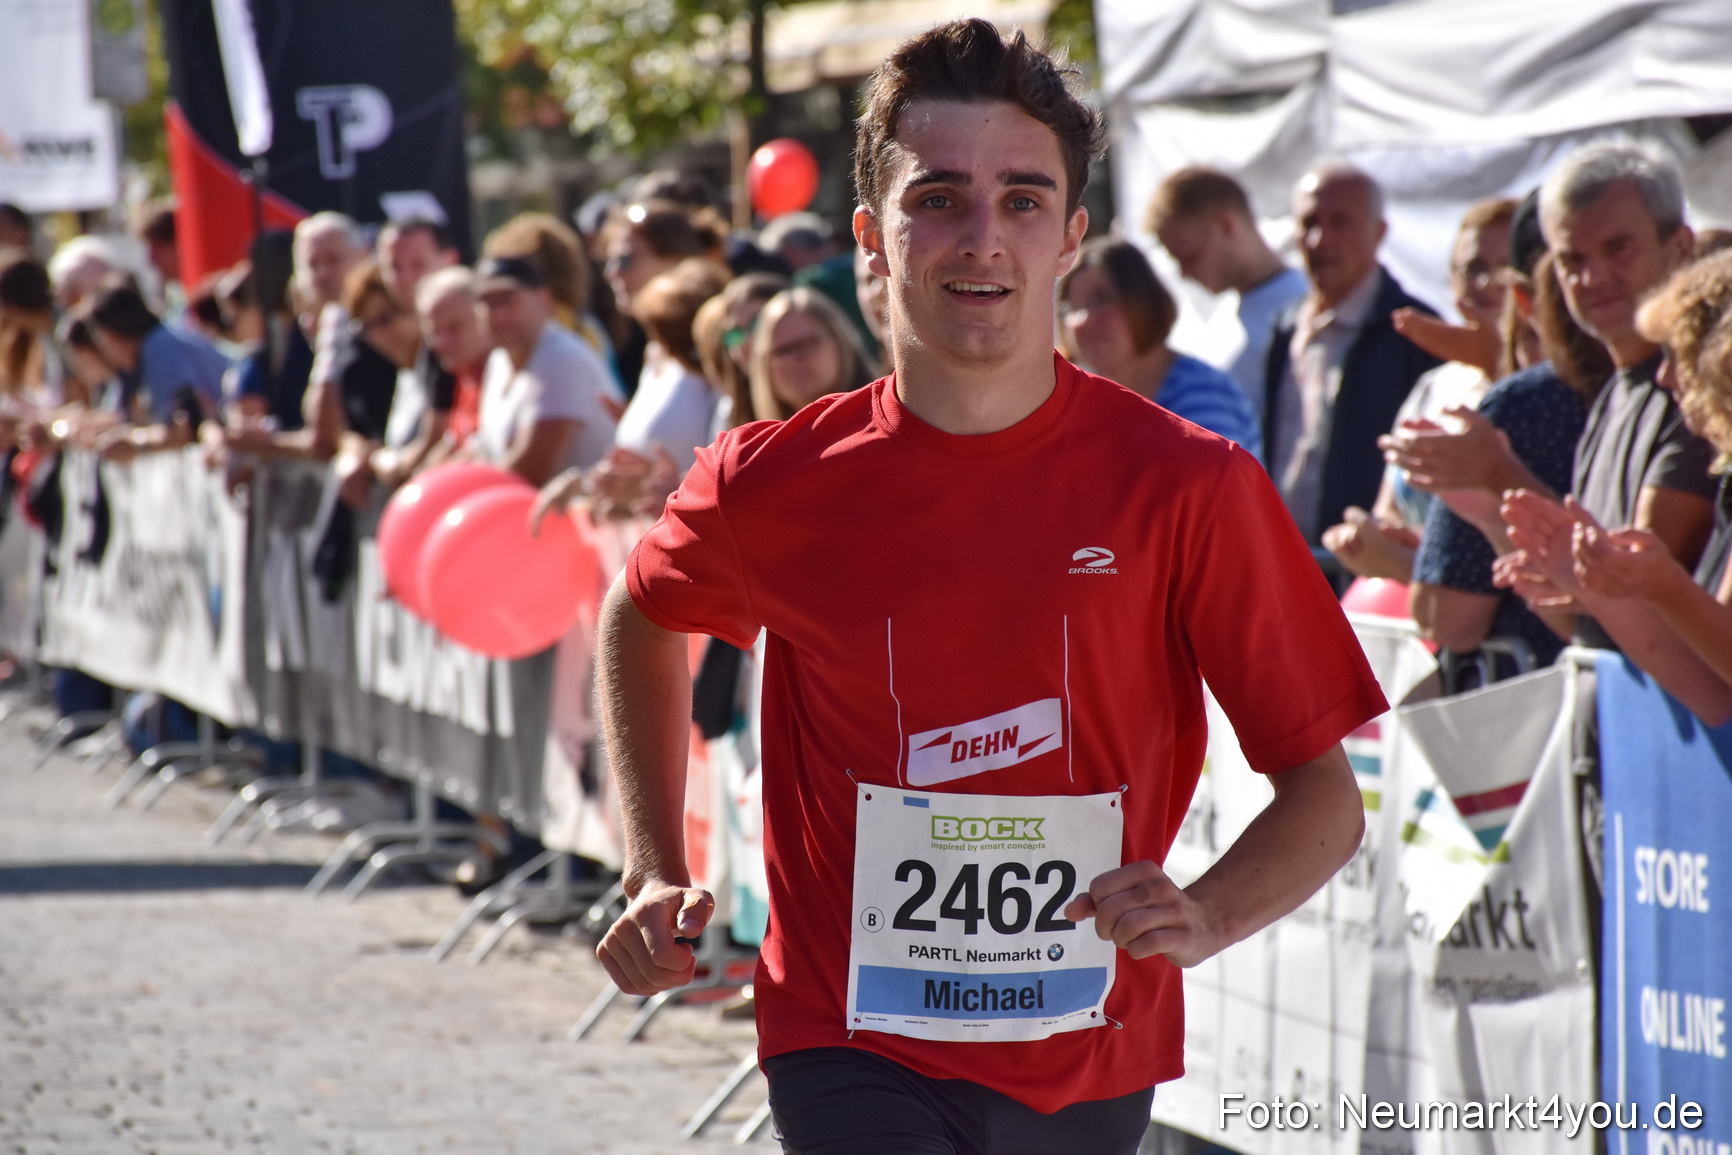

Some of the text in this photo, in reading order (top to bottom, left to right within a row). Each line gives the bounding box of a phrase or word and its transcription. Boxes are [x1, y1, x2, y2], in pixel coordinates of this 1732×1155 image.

[950, 725, 1019, 764] DEHN
[931, 814, 1045, 841] BOCK
[931, 841, 1046, 852] inspired by smart concepts
[1634, 846, 1709, 914] STORE
[892, 859, 1077, 935] 2462
[868, 914, 877, 926] B
[908, 945, 1041, 963] PARTL Neumarkt
[924, 979, 1044, 1012] Michael
[1640, 986, 1726, 1059] ONLINE
